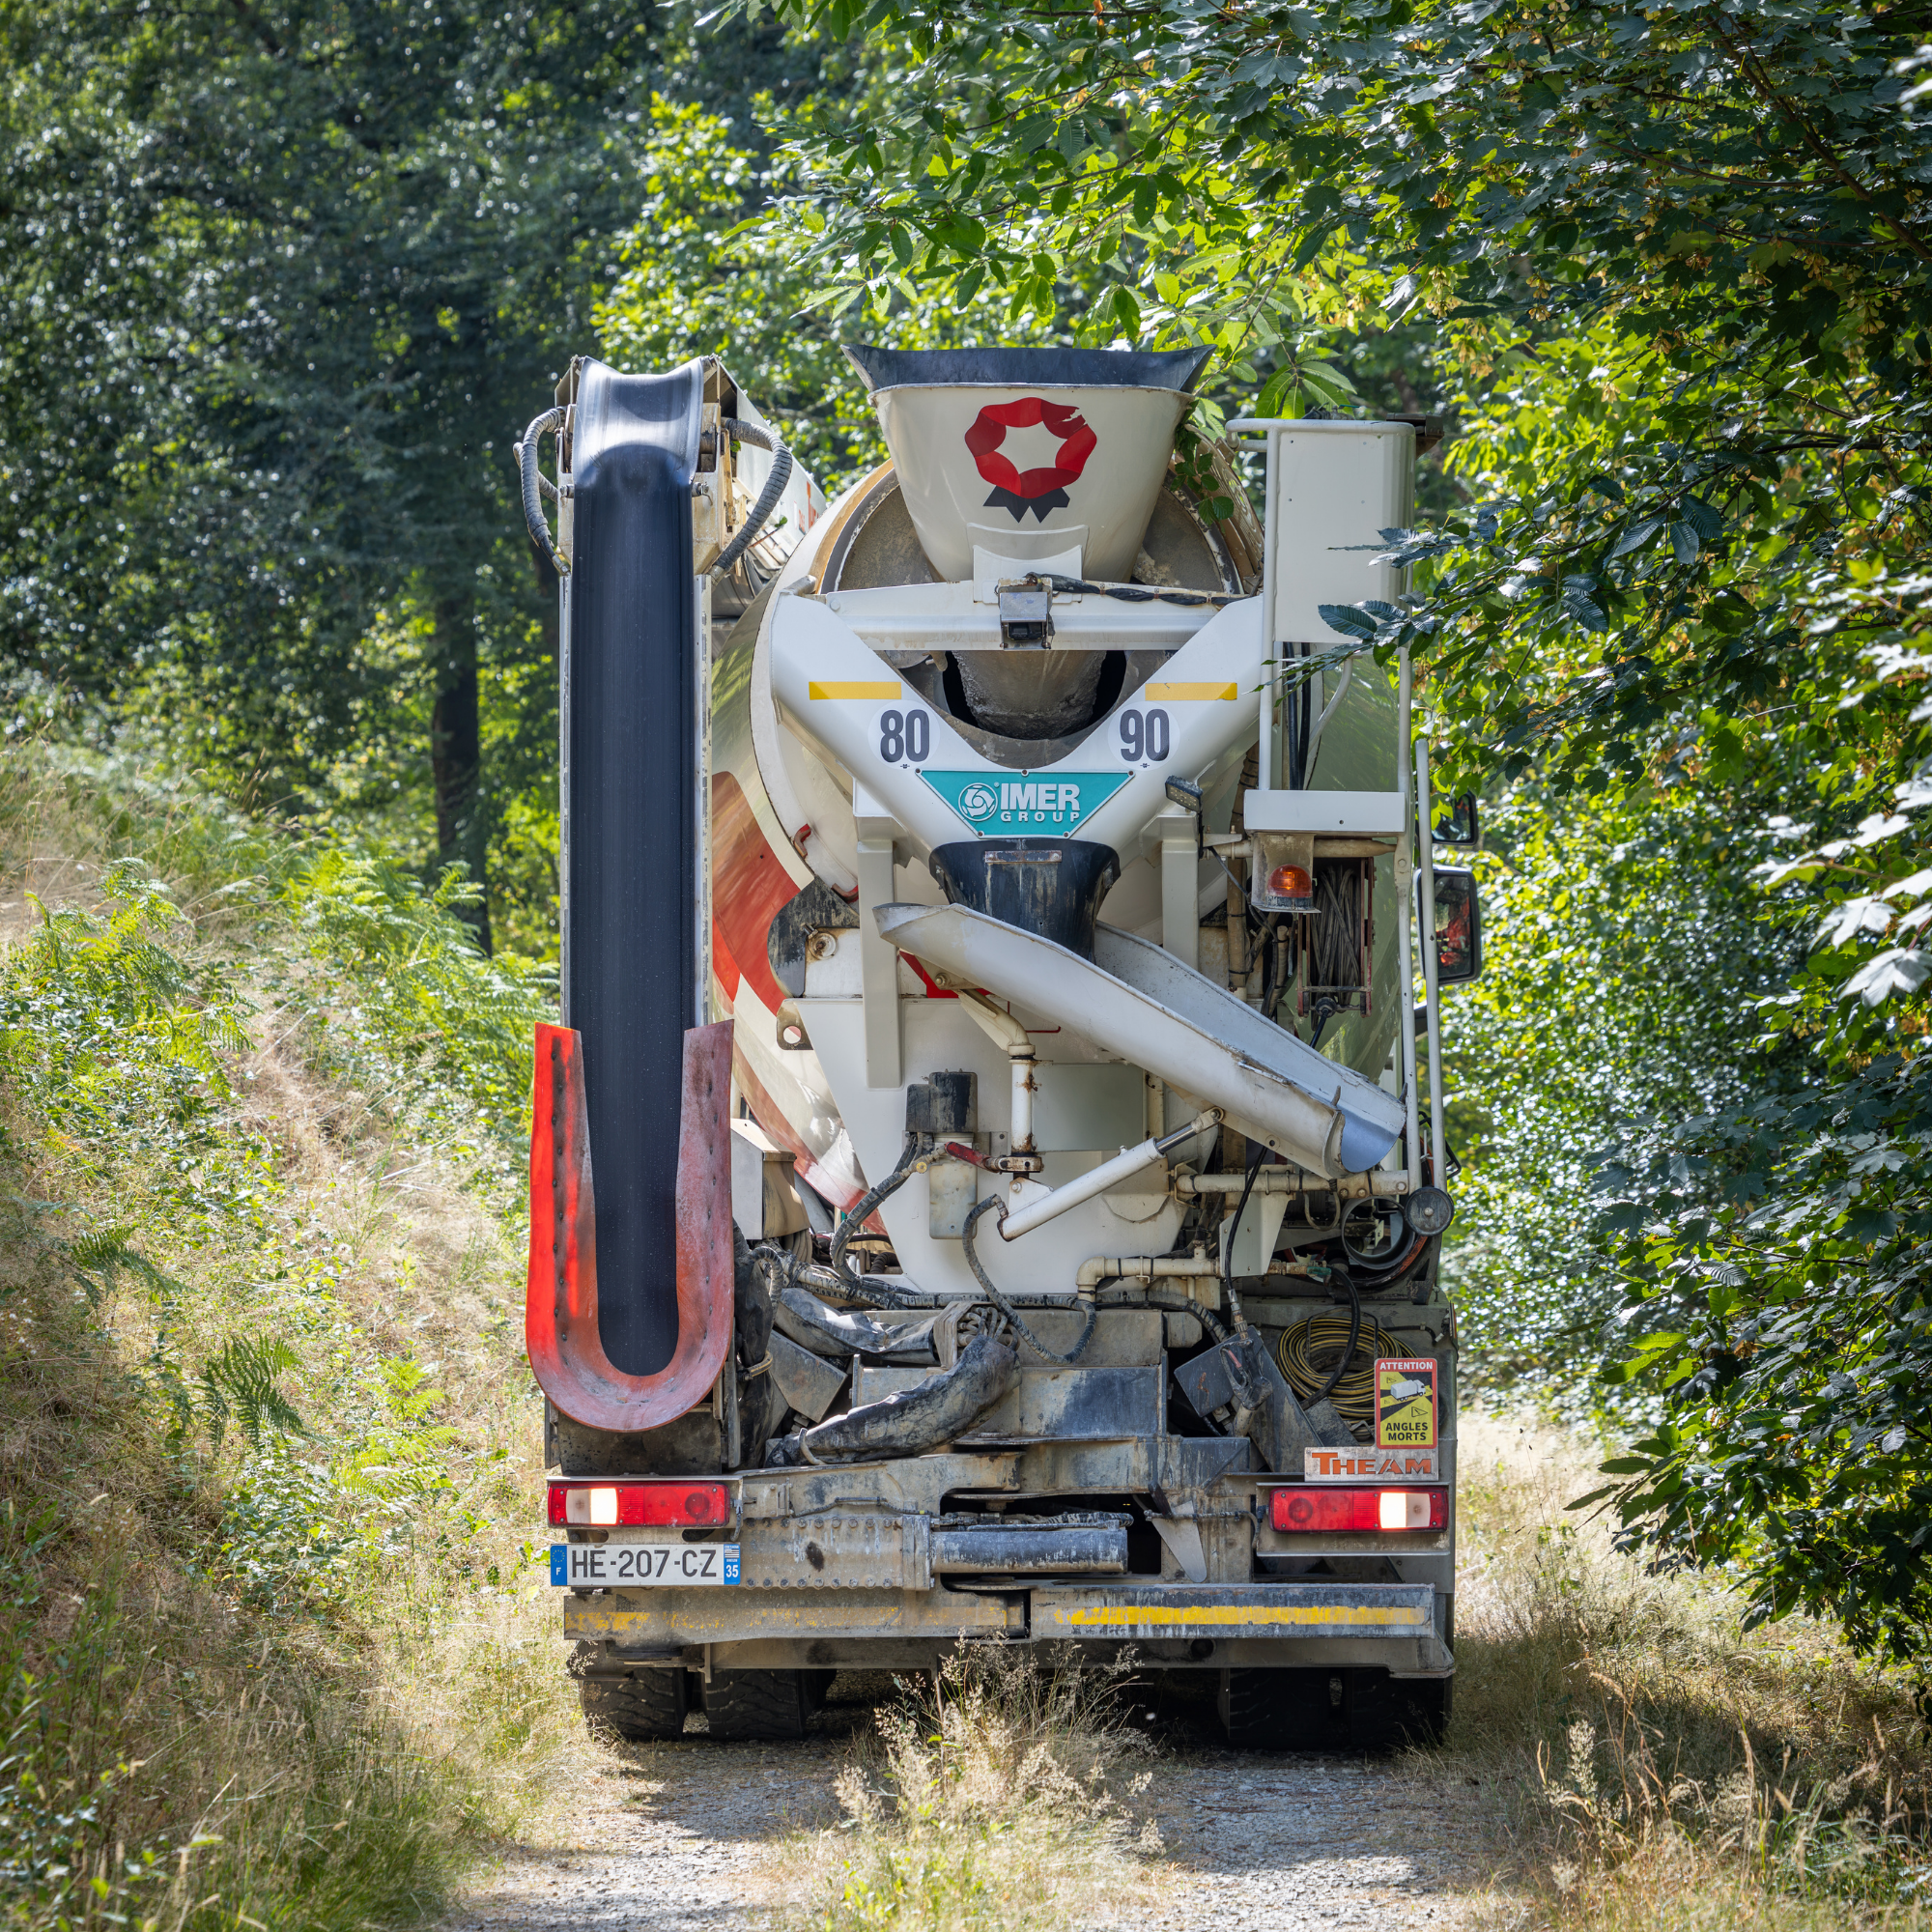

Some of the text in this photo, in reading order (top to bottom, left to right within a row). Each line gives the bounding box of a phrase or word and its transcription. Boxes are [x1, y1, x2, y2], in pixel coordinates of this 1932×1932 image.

[879, 709, 930, 763] 80
[1120, 708, 1170, 762] 90
[1000, 782, 1081, 811] IMER
[1000, 811, 1080, 823] GROUP
[1379, 1361, 1434, 1370] ATTENTION
[1385, 1422, 1429, 1432] ANGLES
[1388, 1432, 1427, 1441] MORTS
[1311, 1452, 1432, 1475] THEAM
[571, 1549, 717, 1577] HE-207-CZ
[555, 1567, 562, 1576] F
[725, 1564, 739, 1578] 35
